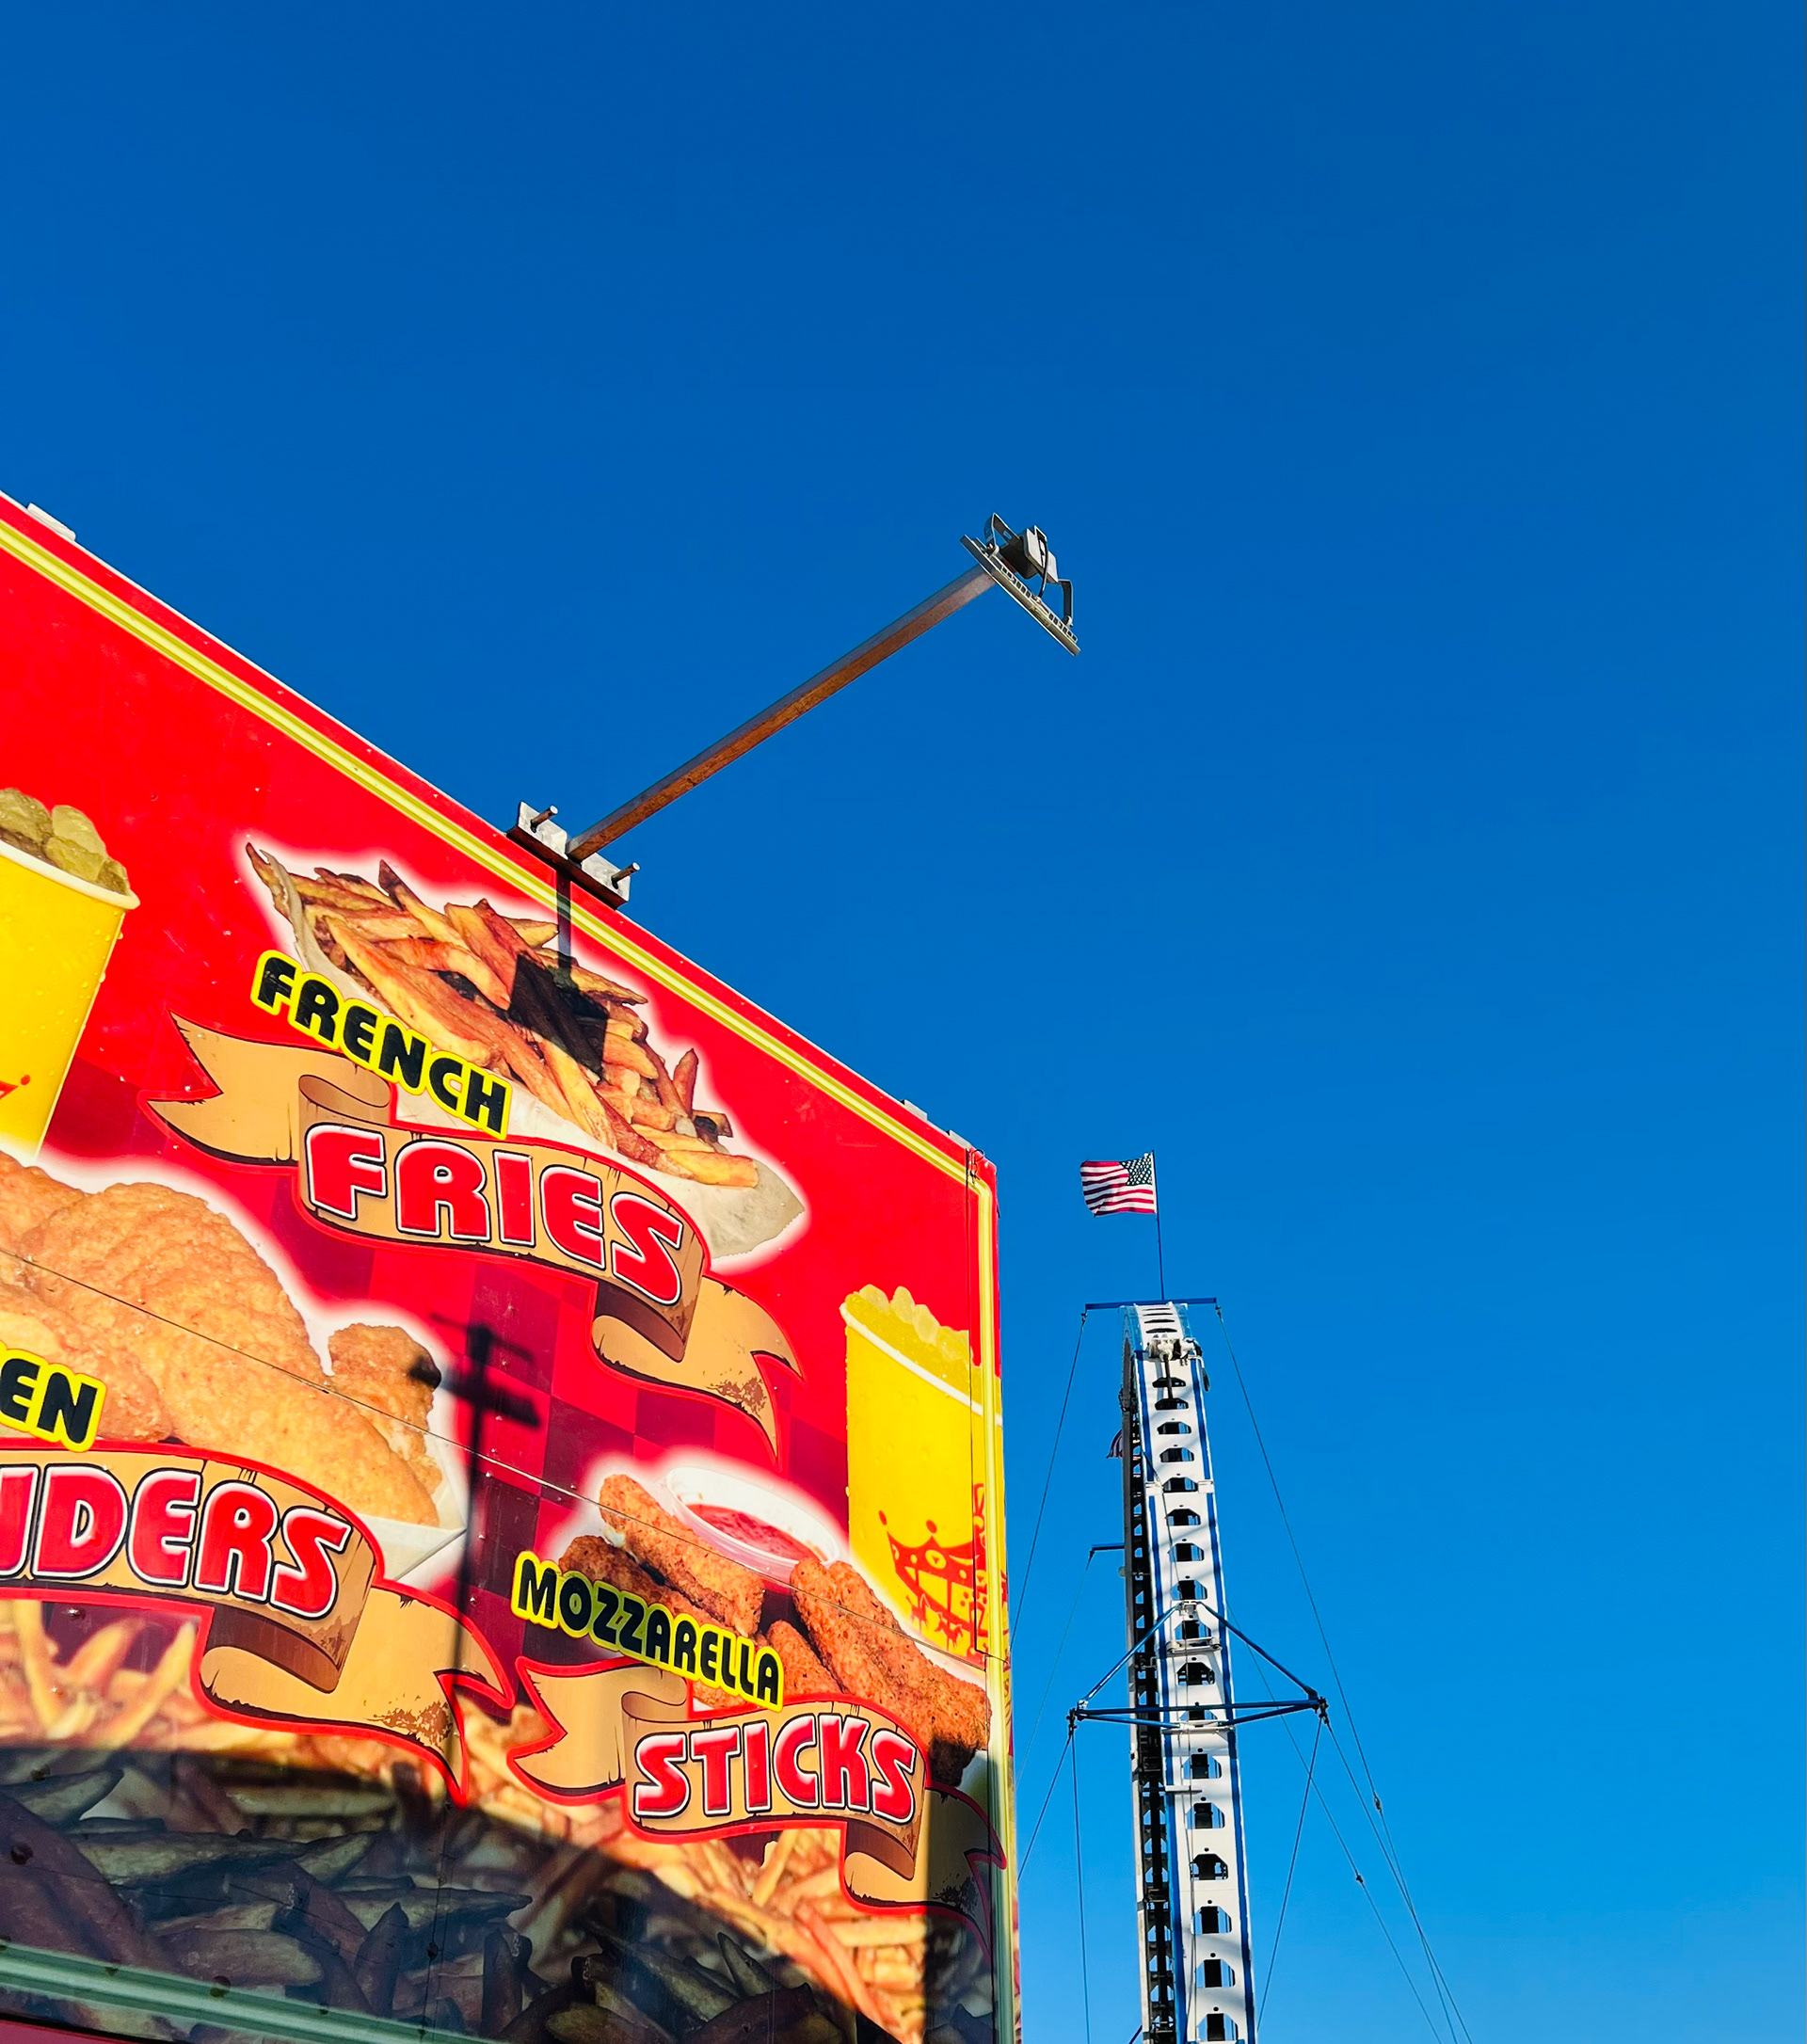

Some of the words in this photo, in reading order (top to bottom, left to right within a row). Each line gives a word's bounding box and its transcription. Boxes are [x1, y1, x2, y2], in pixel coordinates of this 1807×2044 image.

[254, 954, 509, 1135] FRENCH
[304, 1122, 684, 1307] FRIES
[0, 1356, 99, 1445] EN
[515, 1557, 781, 1707] MOZZARELLA
[632, 1713, 918, 1826] STICKS
